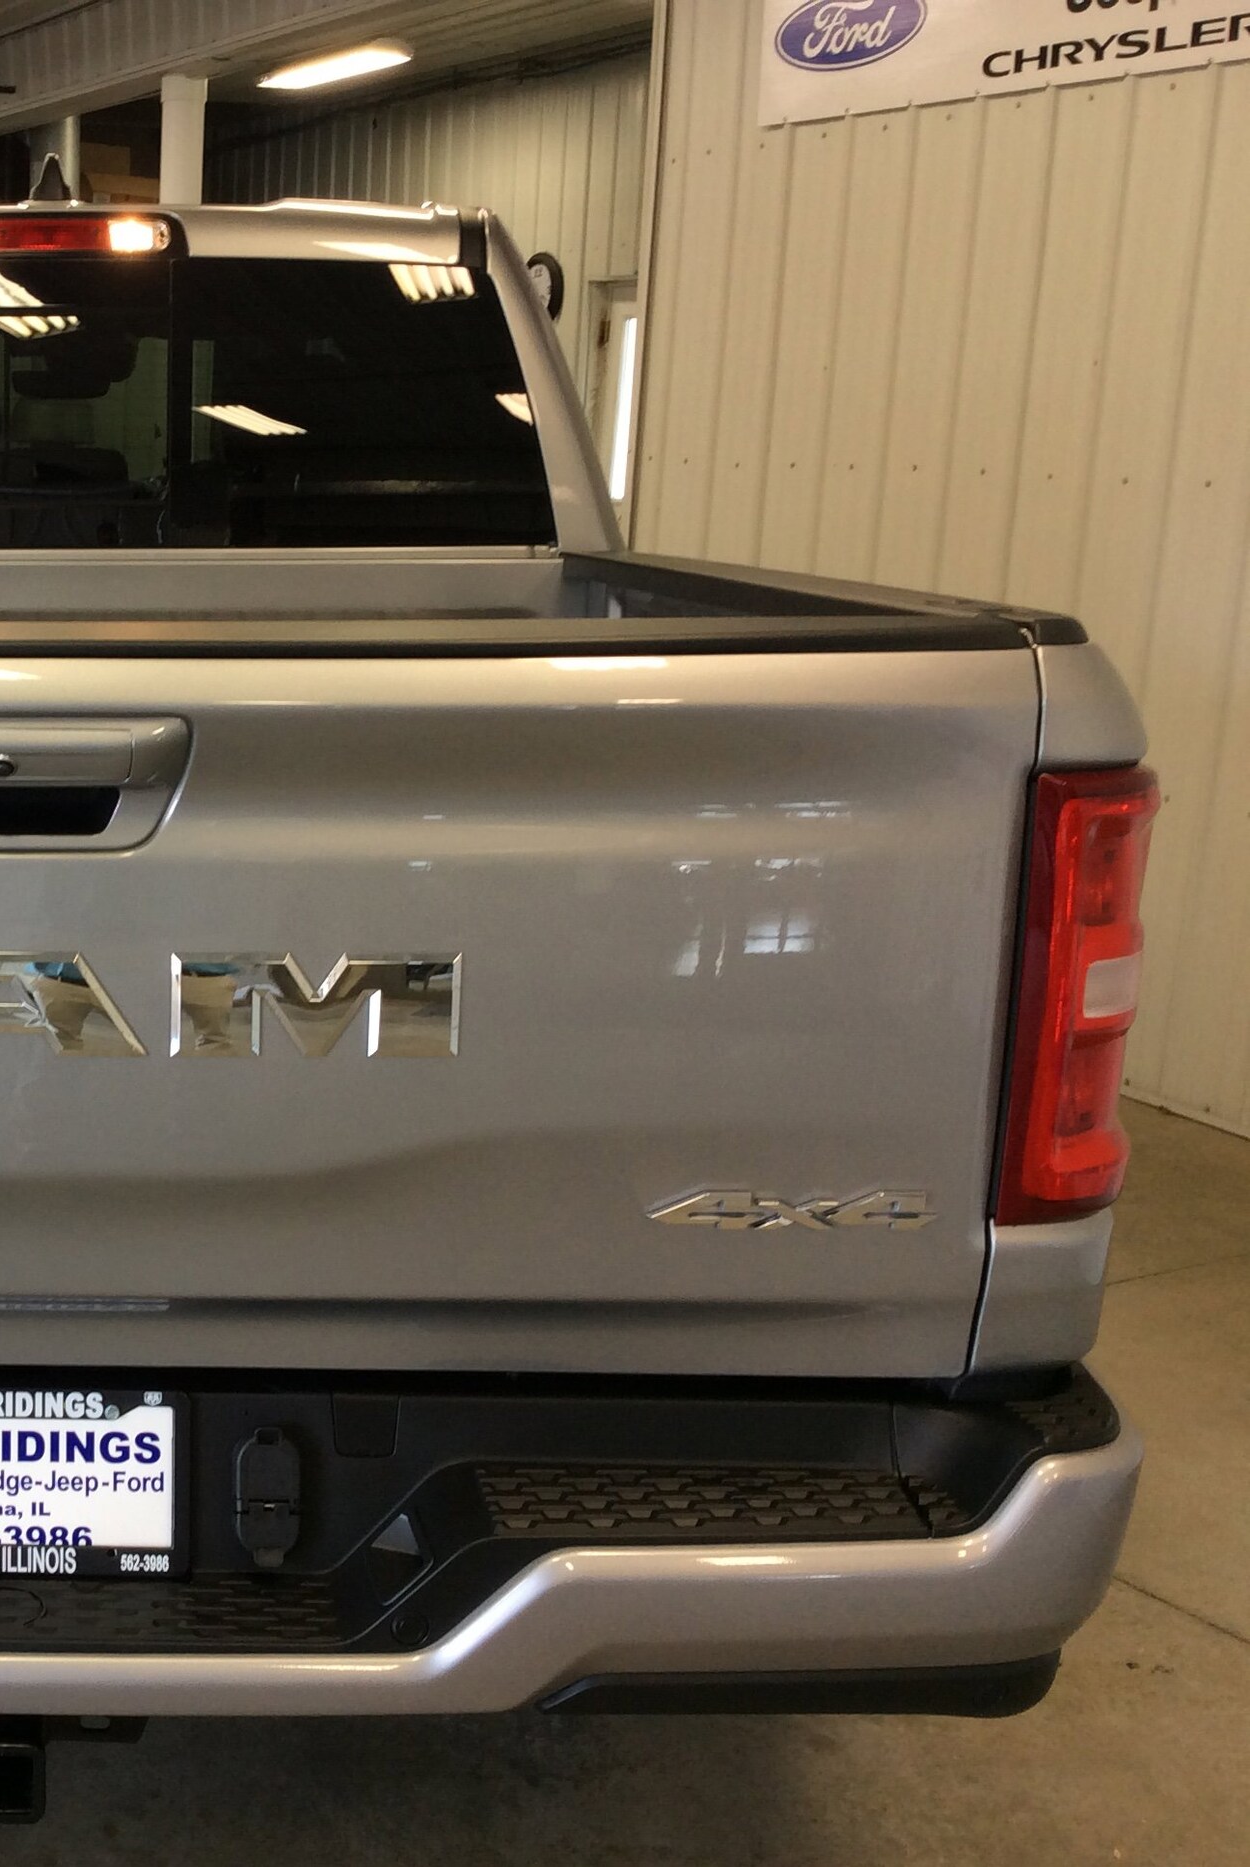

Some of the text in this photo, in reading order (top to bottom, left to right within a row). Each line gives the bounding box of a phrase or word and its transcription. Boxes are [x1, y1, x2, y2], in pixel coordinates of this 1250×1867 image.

[803, 0, 896, 58] Ford
[30, 1502, 51, 1517] IL
[1, 1546, 77, 1575] ILLINOIS
[120, 1553, 170, 1572] 562-3986
